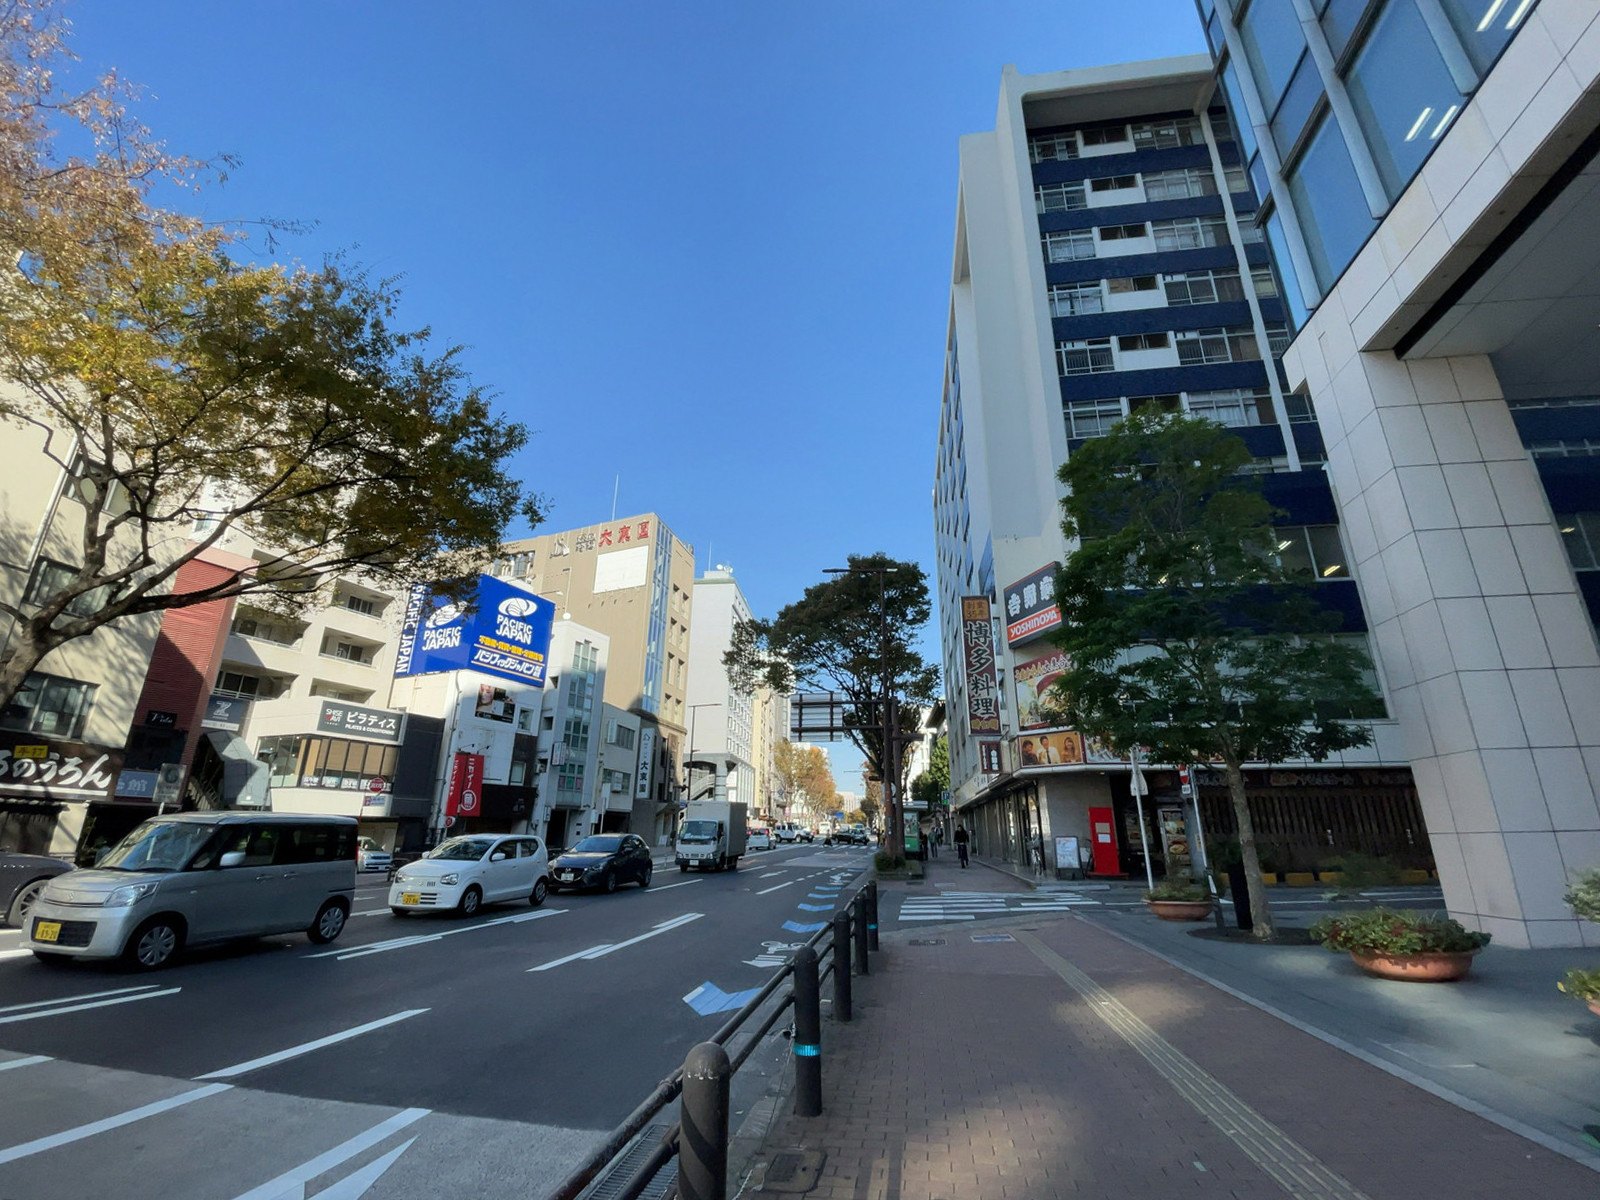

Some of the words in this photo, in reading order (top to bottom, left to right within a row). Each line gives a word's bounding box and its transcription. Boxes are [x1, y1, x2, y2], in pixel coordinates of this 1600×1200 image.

[497, 614, 533, 634] PACIFIC
[1010, 610, 1058, 637] YOSHINOYA
[424, 626, 462, 641] PACIFIC
[495, 628, 532, 645] JAPAN
[422, 636, 461, 651] JAPAN
[396, 634, 416, 673] JAPAN
[964, 621, 997, 717] 博多料理
[346, 711, 396, 729] ピラティス
